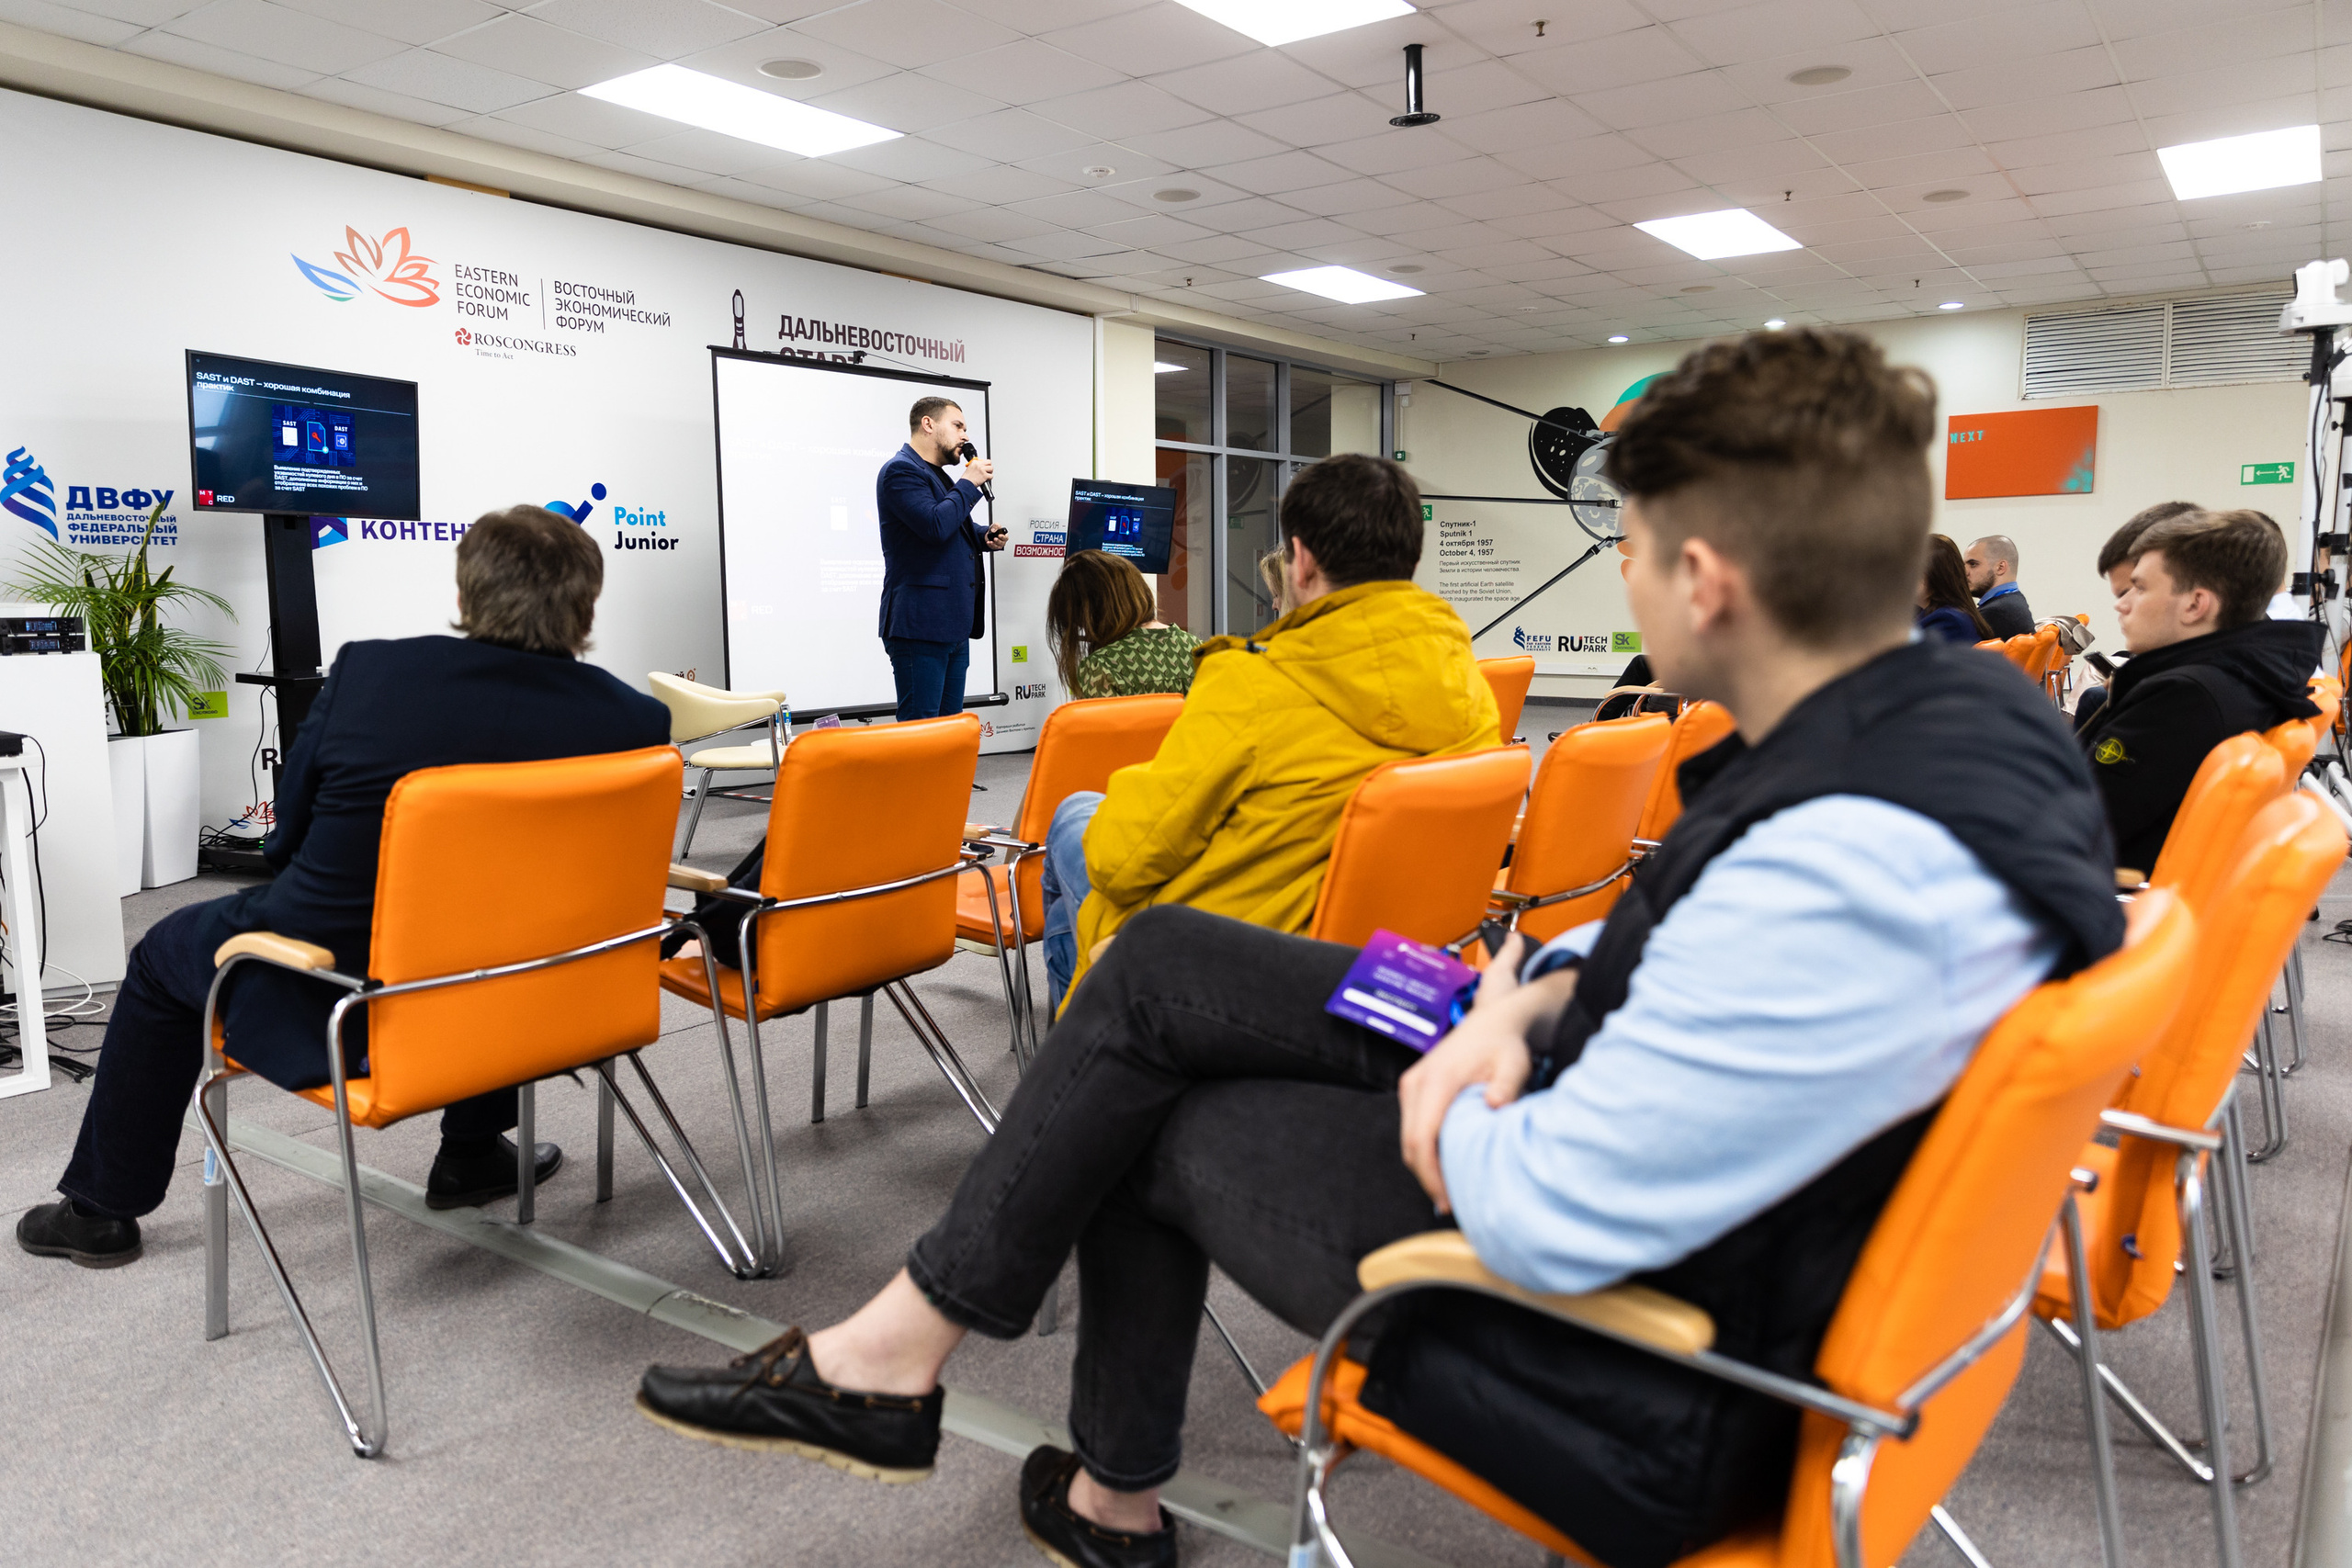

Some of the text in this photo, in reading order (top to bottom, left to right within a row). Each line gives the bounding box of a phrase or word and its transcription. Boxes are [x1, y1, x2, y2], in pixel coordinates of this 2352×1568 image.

[455, 264, 518, 288] EASTERN
[456, 283, 531, 307] ECONOMIC
[554, 280, 636, 306] ВОСТОЧНЫЙ
[457, 300, 508, 321] FORUM
[555, 298, 671, 327] ЭКОНОМИЧЕСКИЙ
[556, 315, 605, 333] ФОРУМ
[474, 333, 577, 357] ROSCONGRESS
[778, 314, 966, 364] ДАЛЬНЕВОСТОЧНЫЙ
[475, 348, 492, 358] Time
[196, 371, 222, 382] SAST
[230, 376, 255, 386] DAST
[263, 381, 300, 393] хорошая
[301, 387, 351, 399] комбинация
[196, 381, 235, 392] практик
[1950, 430, 1984, 444] NEXT
[66, 486, 175, 511] ДВФУ
[216, 494, 235, 503] RED
[615, 506, 666, 527] Point
[1030, 520, 1059, 529] РОССИЯ
[1440, 520, 1476, 529] Спутник-1
[361, 520, 476, 542] КОНТЕН
[1035, 534, 1064, 544] СТРАНА
[1440, 530, 1467, 538] Sputnik
[615, 532, 679, 550] Junior
[1558, 636, 1583, 652] RU
[1583, 636, 1608, 644] TECH
[1615, 633, 1630, 646] Sk
[1015, 684, 1031, 700] RU
